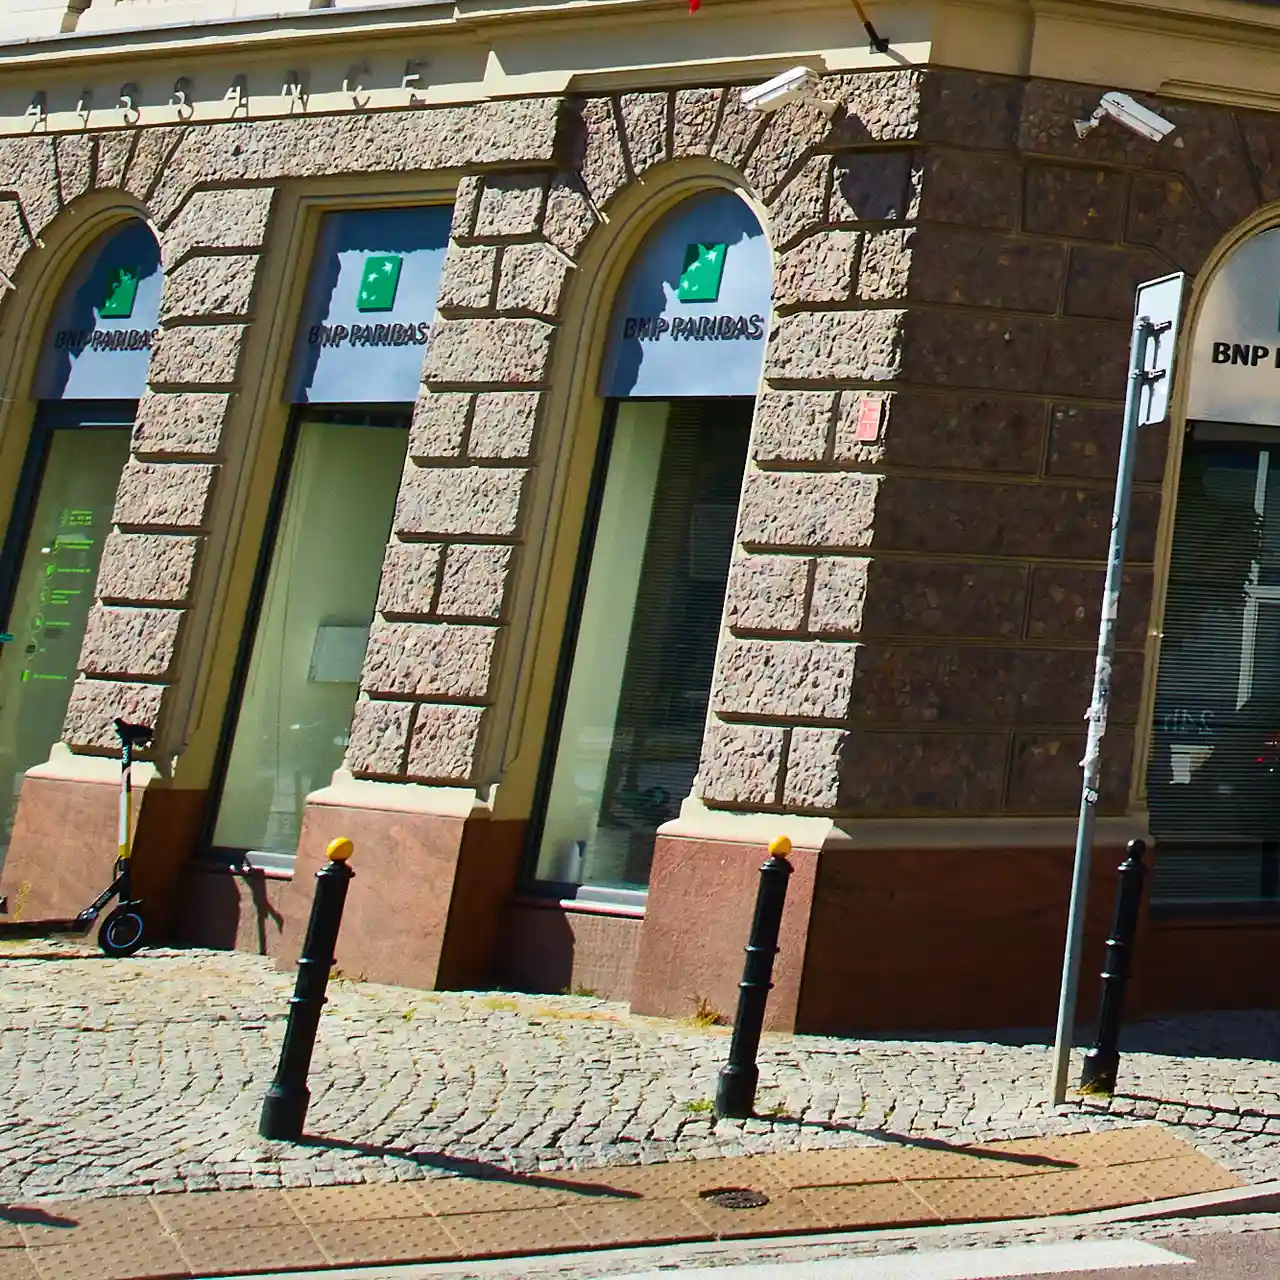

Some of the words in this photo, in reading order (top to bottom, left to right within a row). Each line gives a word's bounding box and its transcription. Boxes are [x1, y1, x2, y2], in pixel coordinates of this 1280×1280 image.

[54, 329, 93, 349] BNP
[309, 324, 349, 348] BNP
[348, 321, 430, 348] PARIBAS
[624, 316, 669, 341] BNP
[671, 314, 765, 341] PARIBAS
[1212, 342, 1269, 366] BNP
